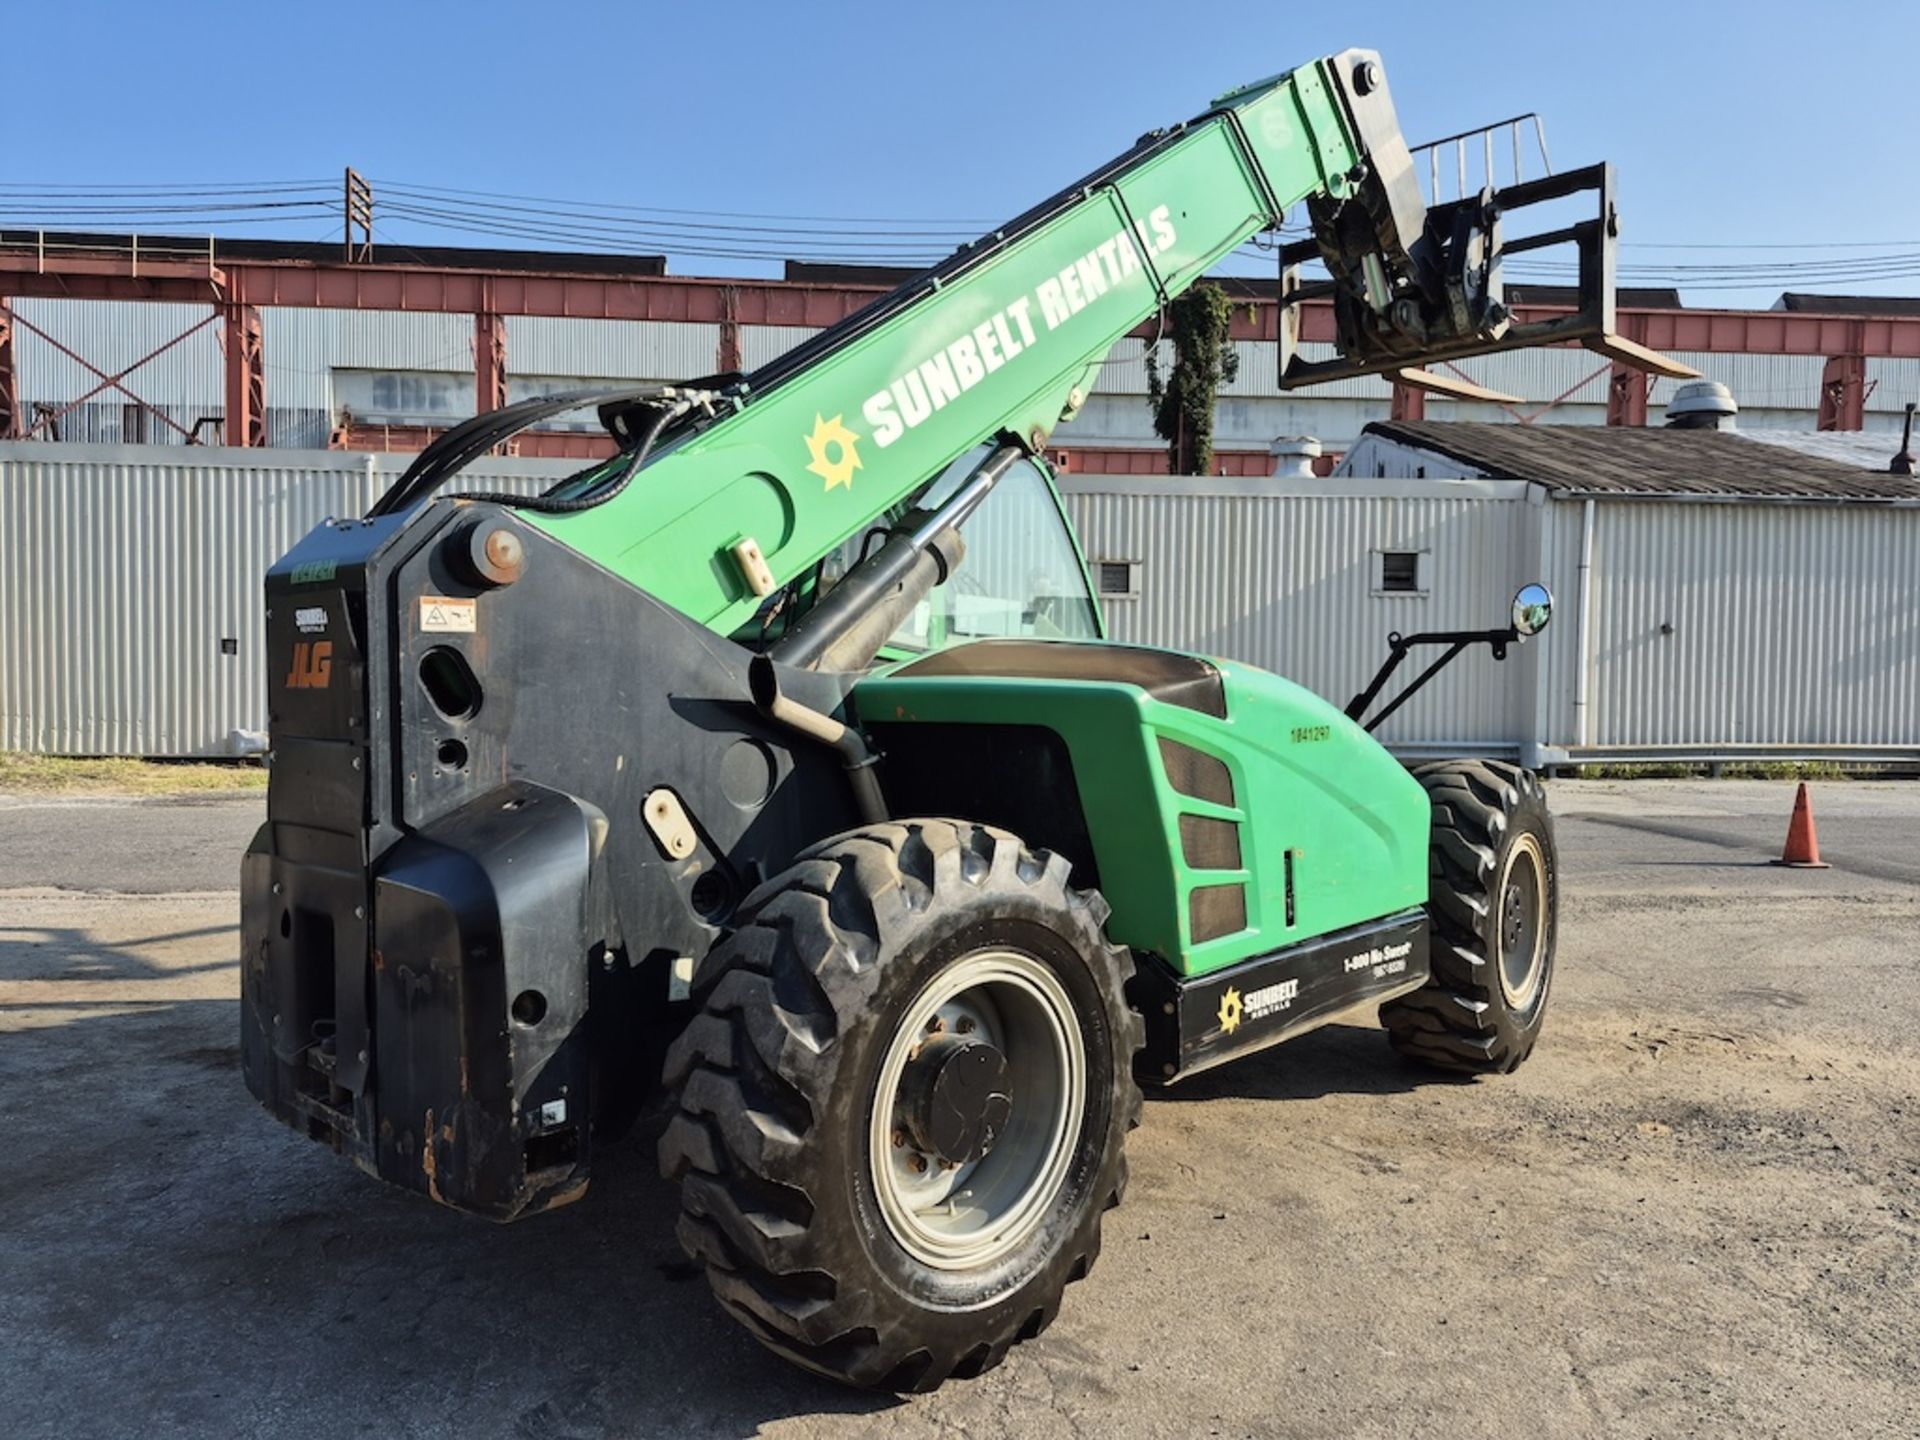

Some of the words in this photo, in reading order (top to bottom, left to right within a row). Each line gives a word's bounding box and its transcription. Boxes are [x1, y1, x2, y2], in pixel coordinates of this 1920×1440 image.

[862, 296, 1036, 448] SUNBELT
[1035, 204, 1176, 331] RENTALS
[286, 641, 333, 688] JLG
[1243, 979, 1299, 1013] SUNBELT
[1250, 1000, 1291, 1020] RENTALS
